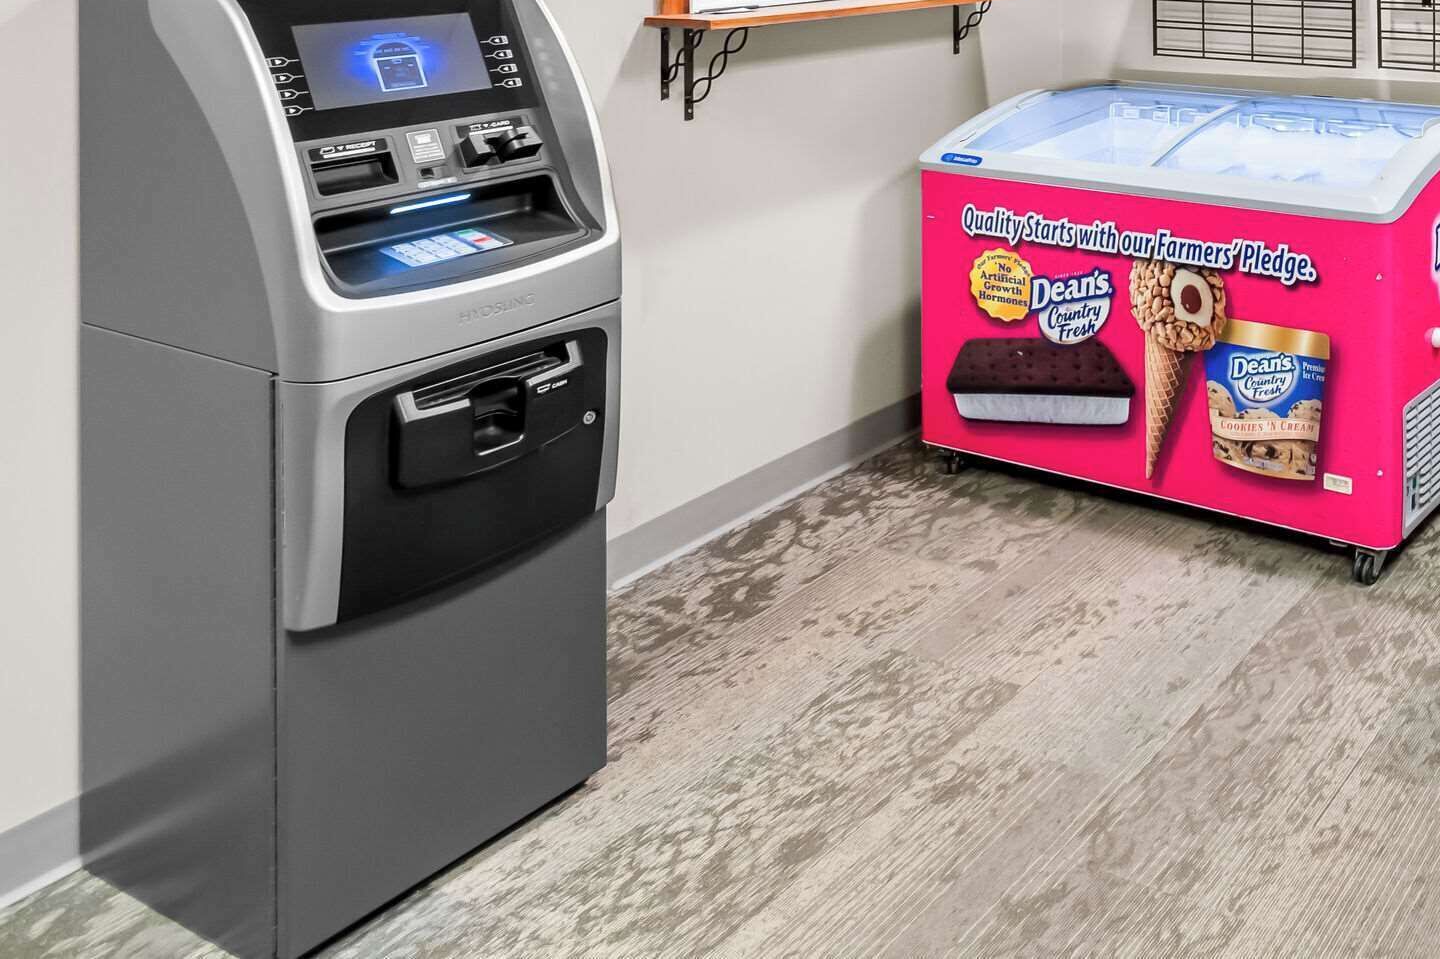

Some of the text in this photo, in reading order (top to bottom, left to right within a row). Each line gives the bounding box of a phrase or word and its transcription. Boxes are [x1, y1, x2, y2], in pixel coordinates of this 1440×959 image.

[345, 140, 376, 150] RECEIPT
[964, 206, 1315, 281] Quality Starts with our Farmers' Pledge.
[980, 270, 1026, 286] Artificial
[984, 281, 1022, 295] Growth
[1032, 270, 1112, 311] Dean's
[979, 290, 1028, 307] Hormones
[1048, 302, 1102, 329] Country
[1059, 322, 1097, 342] Fresh
[1232, 353, 1295, 379] Dean's
[1245, 375, 1286, 390] Country
[1252, 387, 1282, 399] Fresh
[1220, 420, 1263, 432] COOKIES
[1280, 422, 1314, 433] CREAM
